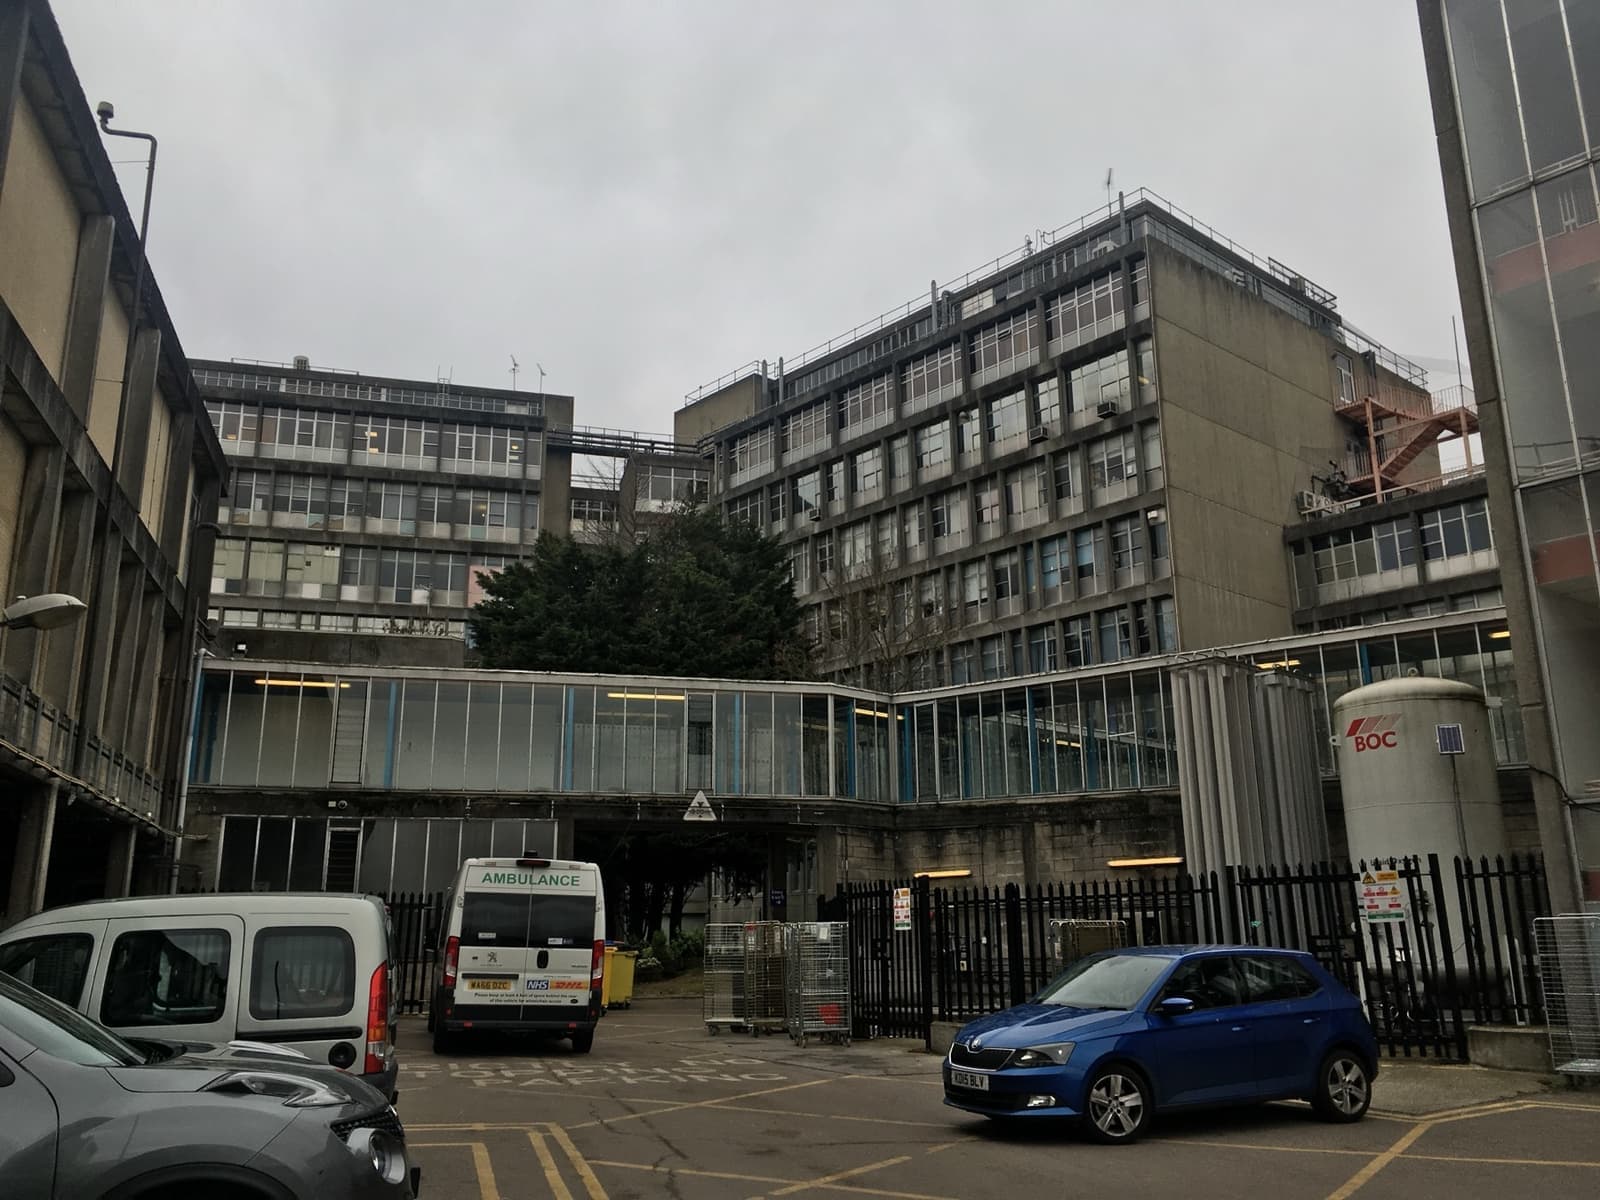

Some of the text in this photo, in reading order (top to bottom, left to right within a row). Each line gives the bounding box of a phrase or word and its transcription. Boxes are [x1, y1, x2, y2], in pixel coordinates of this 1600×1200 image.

[1354, 731, 1397, 753] BOC
[481, 872, 581, 887] AMBULANCE
[527, 981, 548, 989] NHS
[555, 981, 584, 989] DHL
[398, 1058, 766, 1070] RICTLY NO
[399, 1067, 717, 1078] TOPPING
[472, 1073, 788, 1087] PARKING
